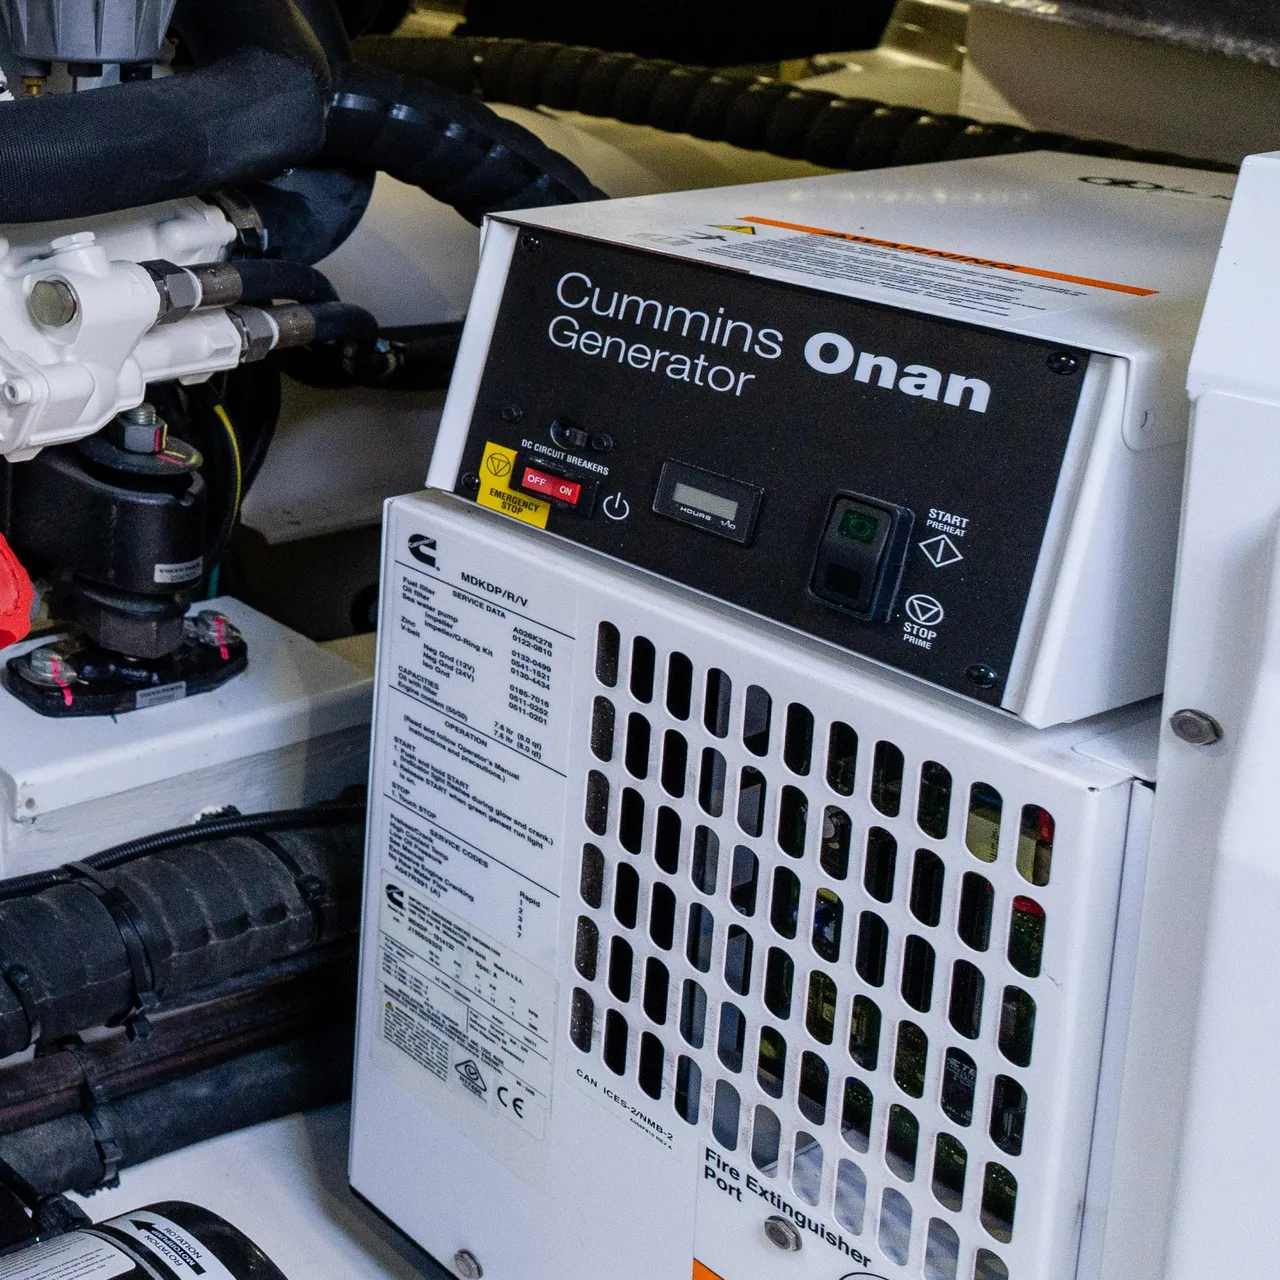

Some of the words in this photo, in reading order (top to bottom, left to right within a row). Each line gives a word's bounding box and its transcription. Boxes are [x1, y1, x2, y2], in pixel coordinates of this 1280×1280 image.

[556, 272, 784, 360] Cummins
[804, 331, 991, 413] Onan
[547, 315, 756, 397] Generator
[521, 439, 532, 450] DC
[534, 443, 565, 460] CIRCUIT
[566, 454, 610, 476] BREAKERS
[527, 474, 546, 486] OFF
[559, 486, 572, 496] ON
[489, 488, 540, 512] EMERGENCY
[501, 501, 523, 515] STOP
[680, 506, 711, 521] HOURS
[928, 508, 969, 528] START
[926, 520, 966, 537] PREHEAT
[402, 577, 418, 588] Fuel
[419, 583, 436, 596] filter
[402, 585, 413, 593] Oil
[414, 589, 430, 602] filter
[460, 572, 528, 607] MDKDP/R/V
[402, 593, 415, 603] Sea
[417, 600, 436, 614] water
[438, 610, 459, 623] pump
[452, 590, 484, 609] SERVICE
[485, 605, 507, 619] DATA
[400, 623, 421, 638] V-belt
[424, 612, 453, 630] Impeller
[903, 622, 937, 640] STOP
[400, 616, 416, 628] Zinc
[424, 620, 481, 652] Impeller/O-Ring
[482, 646, 493, 658] Kit
[512, 626, 553, 649] A026K278
[512, 634, 552, 657] 0122-0810
[903, 634, 932, 650] PRIME
[422, 652, 437, 665] Neg
[438, 658, 454, 672] Gnd
[455, 667, 475, 682] (24V)
[422, 660, 434, 670] Iso
[434, 666, 450, 679] Gnd
[423, 643, 438, 656] Neg
[438, 649, 455, 662] Gnd
[455, 658, 475, 673] (12V)
[510, 658, 551, 682] 0541-1521
[511, 650, 552, 673] 0132-0499
[398, 665, 439, 690] CAPACITIES
[408, 678, 422, 689] with
[422, 684, 438, 697] filter
[510, 667, 550, 691] 0130-4434
[397, 681, 420, 697] Engine
[420, 692, 445, 709] coolant
[445, 705, 468, 722] (50/50)
[394, 736, 416, 752] START
[404, 714, 422, 727] (Read
[423, 724, 436, 735] and
[437, 731, 456, 747] follow
[458, 743, 493, 767] Operator's
[495, 762, 519, 780] Manual
[444, 720, 488, 748] OPERATION
[517, 732, 531, 745] (8.0
[531, 739, 542, 752] qt)
[408, 726, 447, 750] instructions
[447, 747, 460, 758] and
[461, 755, 506, 783] precautions.)
[516, 741, 530, 754] (8.0
[530, 748, 542, 760] qt)
[400, 748, 417, 760] Push
[418, 758, 430, 769] and
[431, 764, 445, 777] hold
[447, 773, 470, 790] START
[406, 776, 416, 787] on.
[391, 781, 410, 795] STOP
[400, 755, 430, 774] (Indicator
[431, 771, 446, 785] light
[447, 779, 470, 798] flashes
[472, 792, 493, 812] during
[495, 809, 512, 823] glow
[513, 819, 527, 831] and
[528, 827, 554, 846] crank.)
[398, 794, 417, 810] Touch
[418, 805, 436, 820] STOP
[400, 764, 425, 783] Release
[425, 778, 448, 796] START
[449, 792, 467, 806] when
[468, 802, 487, 819] green
[488, 814, 512, 832] genset
[513, 828, 526, 840] run
[527, 835, 544, 850] light
[389, 829, 403, 841] Low
[414, 843, 442, 865] Pressure
[389, 836, 401, 847] See
[402, 845, 424, 863] Manual
[390, 822, 403, 834] High
[405, 830, 430, 849] Coolant
[432, 846, 449, 861] Temp
[430, 828, 461, 852] SERVICE
[462, 848, 488, 869] CODES
[389, 844, 420, 868] Excessive
[421, 864, 443, 883] Engine
[444, 878, 474, 902] Cranking
[398, 858, 412, 870] Raw
[413, 867, 431, 882] Water
[432, 879, 448, 893] Flow
[430, 885, 441, 898] (A)
[520, 891, 540, 908] Rapid
[577, 1069, 598, 1088] CAN
[603, 1087, 673, 1141] ICES-2/NMB-2
[656, 1136, 667, 1145] REV
[704, 1165, 742, 1203] Port
[705, 1147, 740, 1181] Fire
[746, 1174, 872, 1268] Extinguisher
[144, 1235, 183, 1266] ROTATION
[151, 1230, 196, 1266] MOTORPUMP
[163, 1228, 203, 1259] ROTATION
